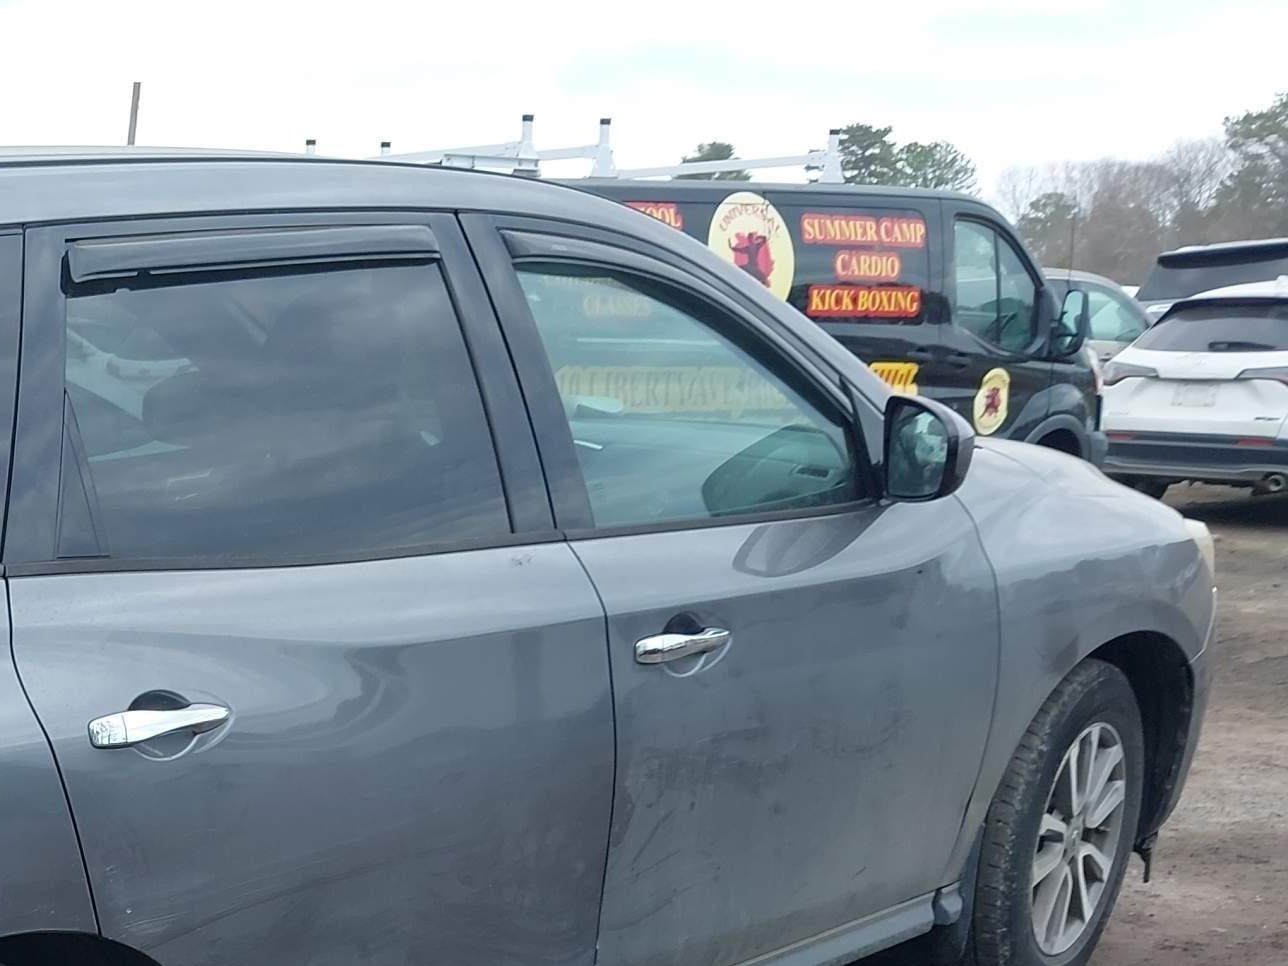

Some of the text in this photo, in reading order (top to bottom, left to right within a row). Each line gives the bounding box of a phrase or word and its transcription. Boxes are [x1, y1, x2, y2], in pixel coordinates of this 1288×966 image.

[804, 218, 926, 243] SUMMER CAMP
[836, 254, 900, 278] CARDIO
[812, 289, 919, 313] KICK BOXING
